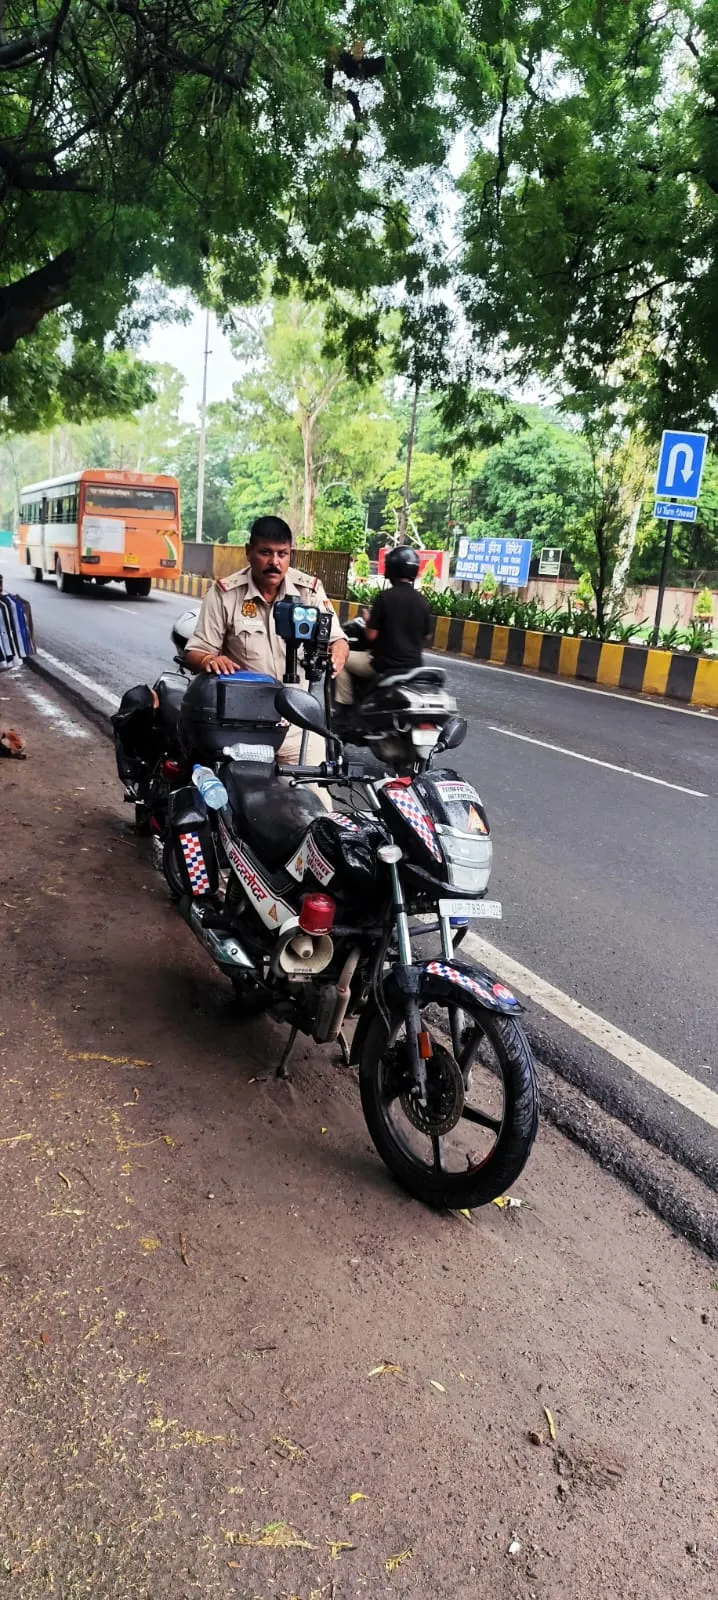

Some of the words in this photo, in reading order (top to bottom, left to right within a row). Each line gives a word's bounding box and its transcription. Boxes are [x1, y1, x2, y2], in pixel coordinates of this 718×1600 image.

[664, 506, 675, 516] Turn
[676, 508, 695, 518] Ahead
[497, 565, 520, 577] LIMITED
